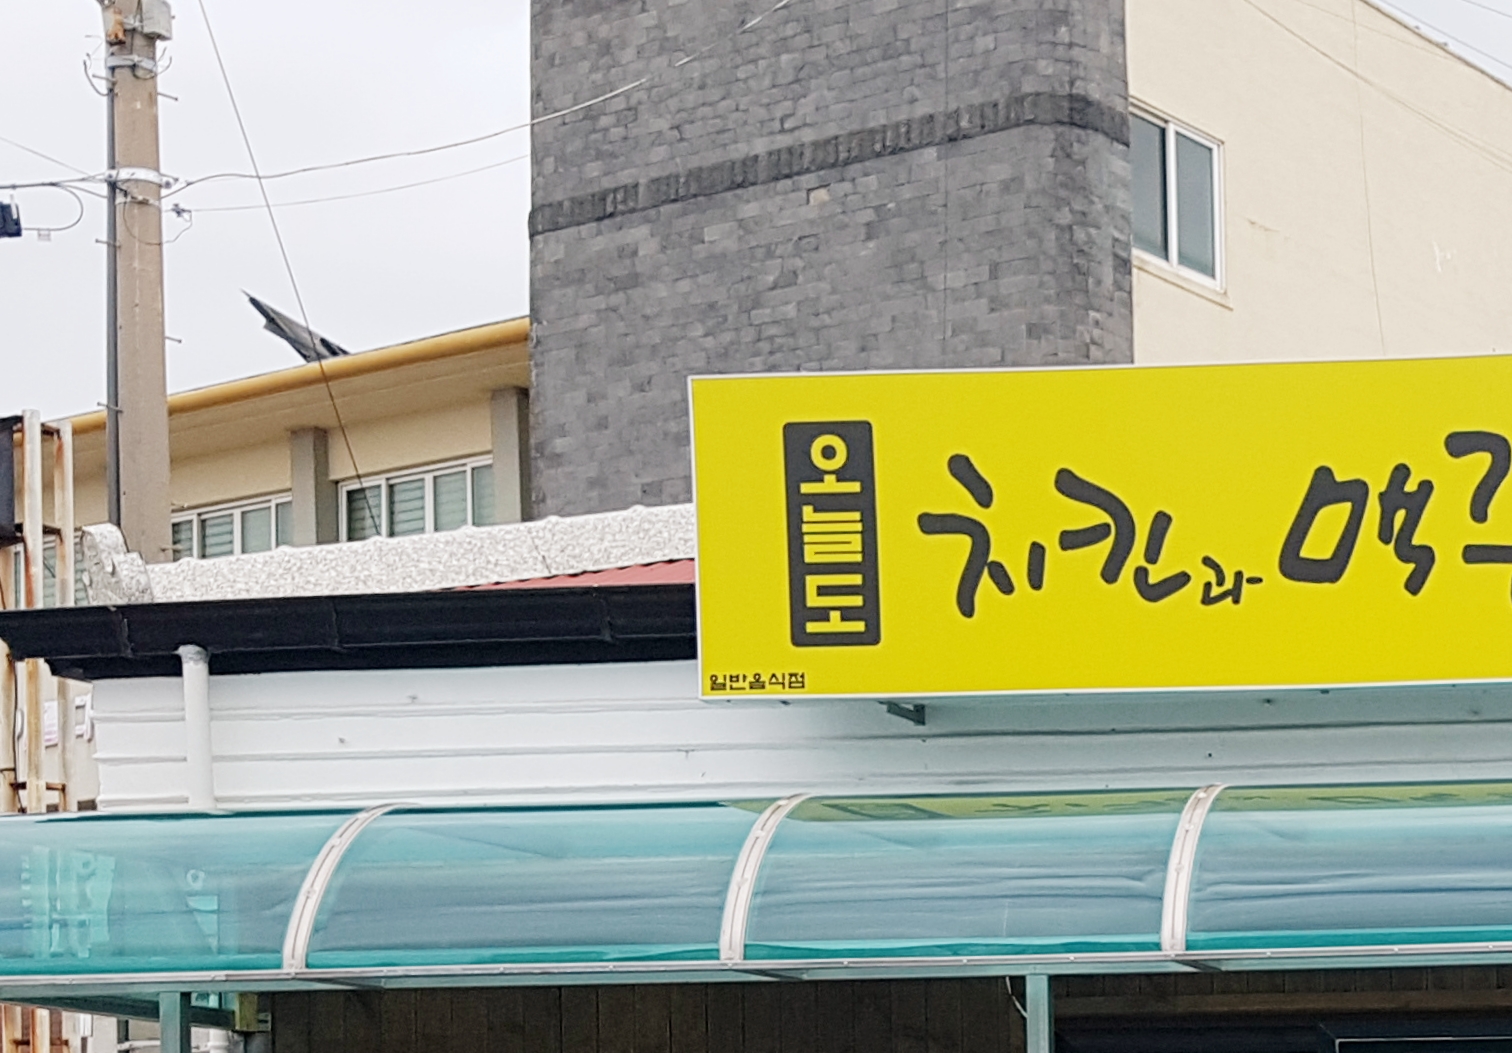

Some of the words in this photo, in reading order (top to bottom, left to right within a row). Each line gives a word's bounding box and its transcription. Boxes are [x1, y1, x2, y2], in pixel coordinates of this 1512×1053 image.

[798, 431, 869, 635] 오늘도
[917, 453, 1264, 619] 치킨과
[709, 672, 805, 691] 일반음식점
